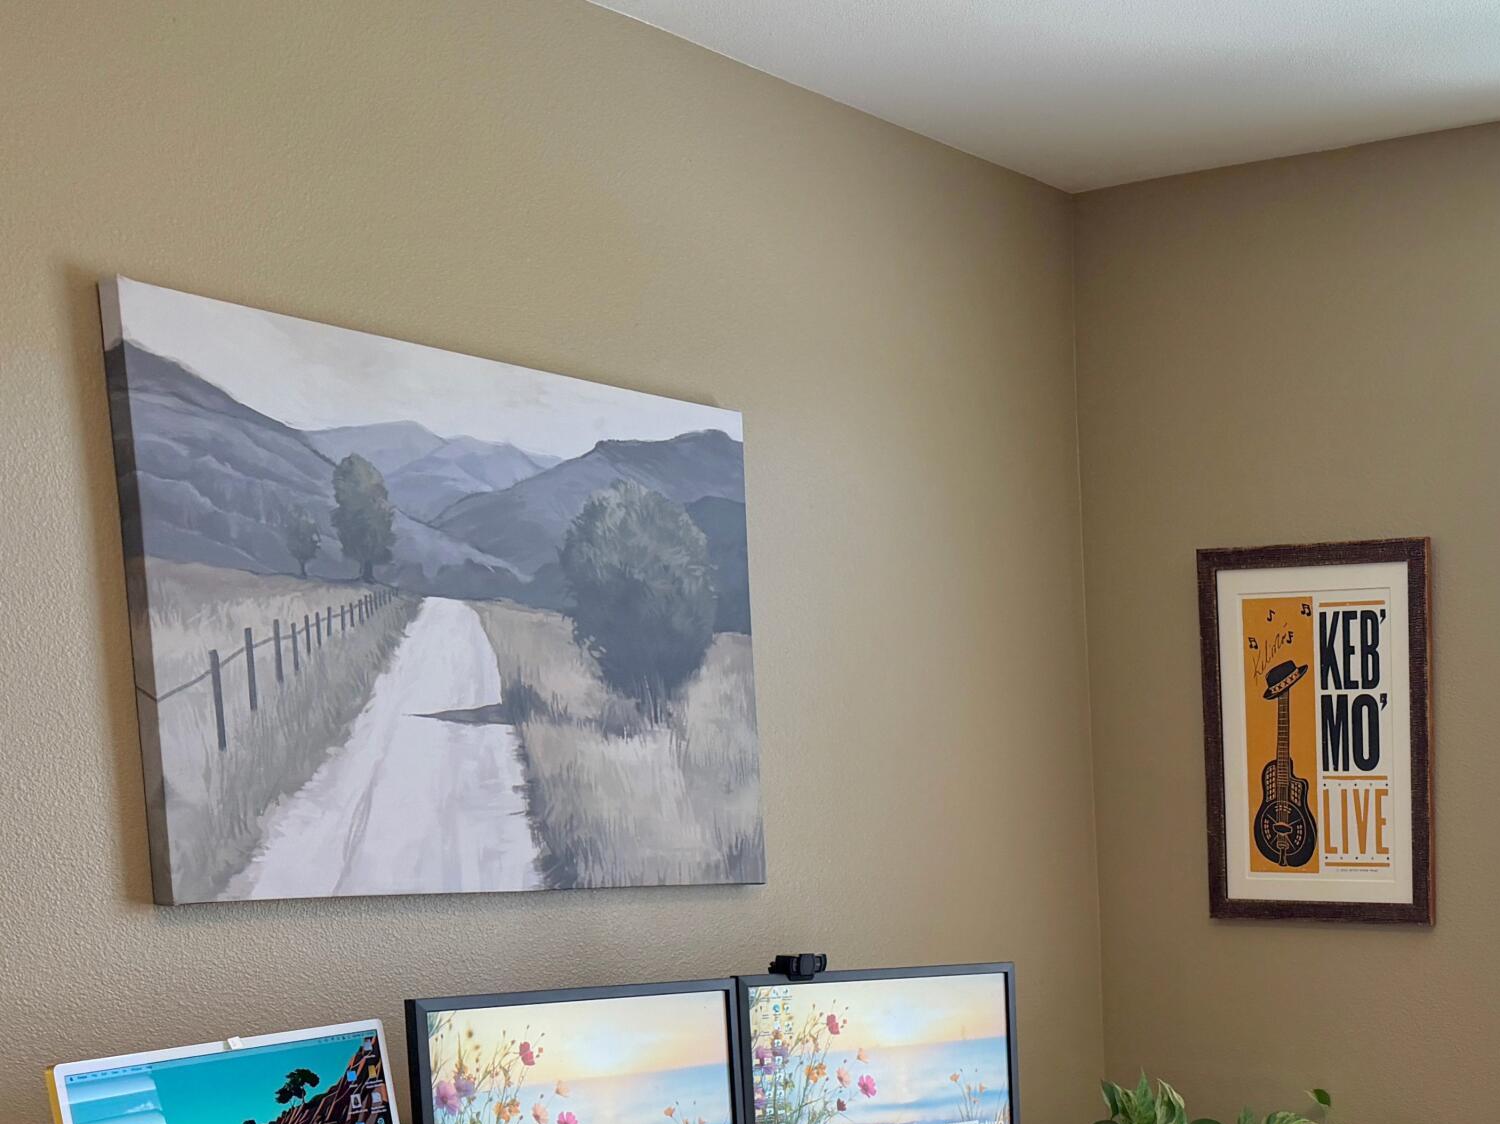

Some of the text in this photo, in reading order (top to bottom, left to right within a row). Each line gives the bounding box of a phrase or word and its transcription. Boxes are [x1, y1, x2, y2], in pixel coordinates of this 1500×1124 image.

[1319, 609, 1386, 690] KEB'
[1321, 693, 1388, 771] MO'
[1323, 788, 1389, 854] LIVE
